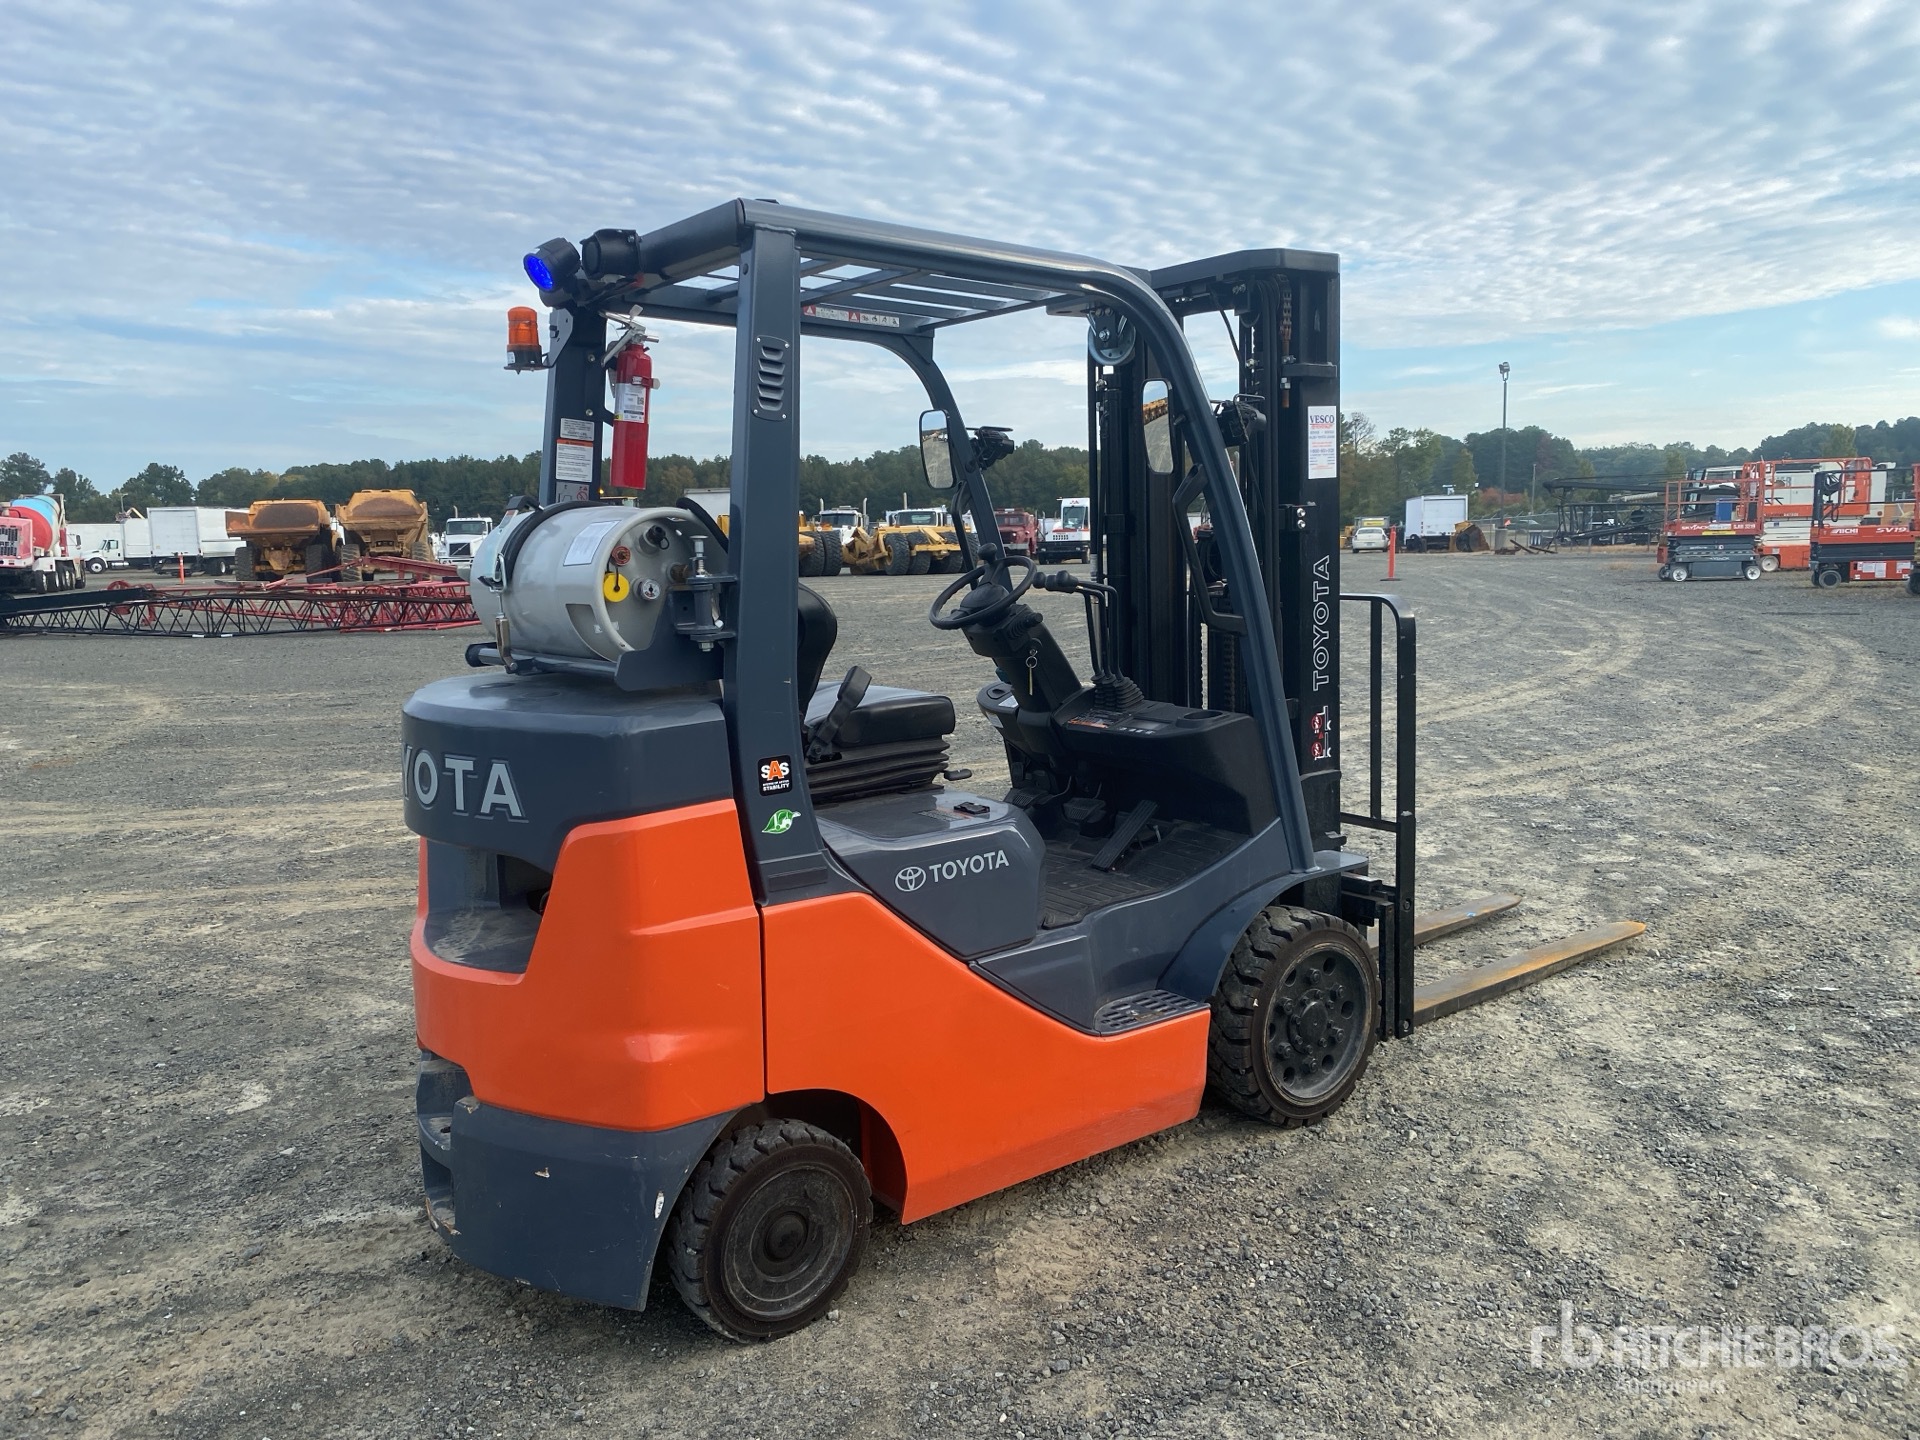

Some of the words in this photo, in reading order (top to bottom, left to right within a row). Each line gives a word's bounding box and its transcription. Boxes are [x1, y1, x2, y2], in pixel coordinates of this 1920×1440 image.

[1310, 415, 1335, 424] VESCO
[1313, 555, 1330, 691] TOYOTA
[761, 760, 790, 780] SAS
[929, 849, 1010, 882] TOYOTA
